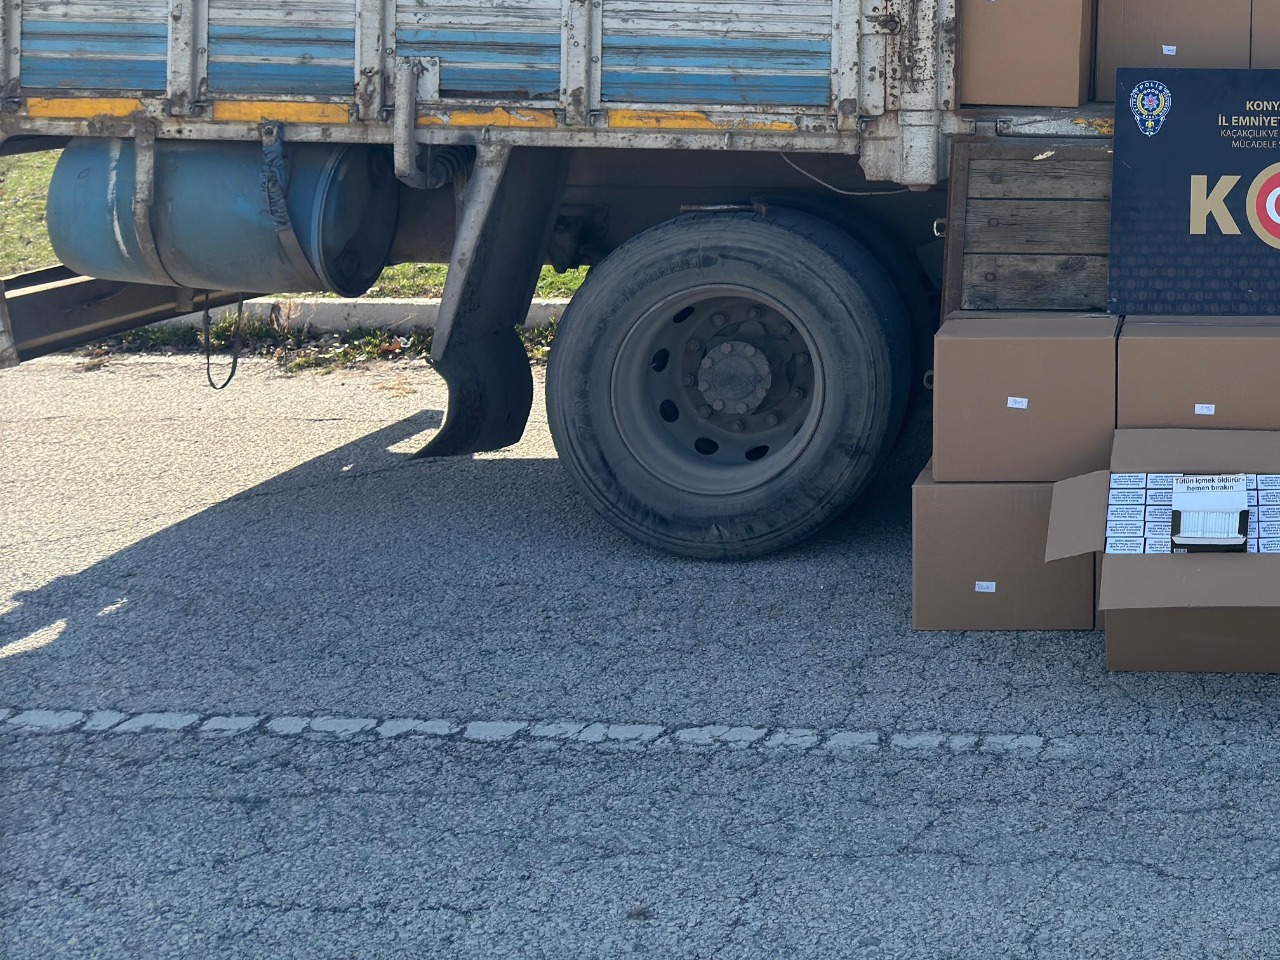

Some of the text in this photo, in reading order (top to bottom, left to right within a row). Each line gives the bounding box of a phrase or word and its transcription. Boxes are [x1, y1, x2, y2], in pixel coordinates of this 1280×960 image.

[1218, 113, 1229, 126] İL
[1220, 129, 1267, 139] KAÇAKÇILIK
[1268, 129, 1279, 137] VE
[1231, 139, 1277, 148] MÜCADELE
[1195, 476, 1216, 484] içmek
